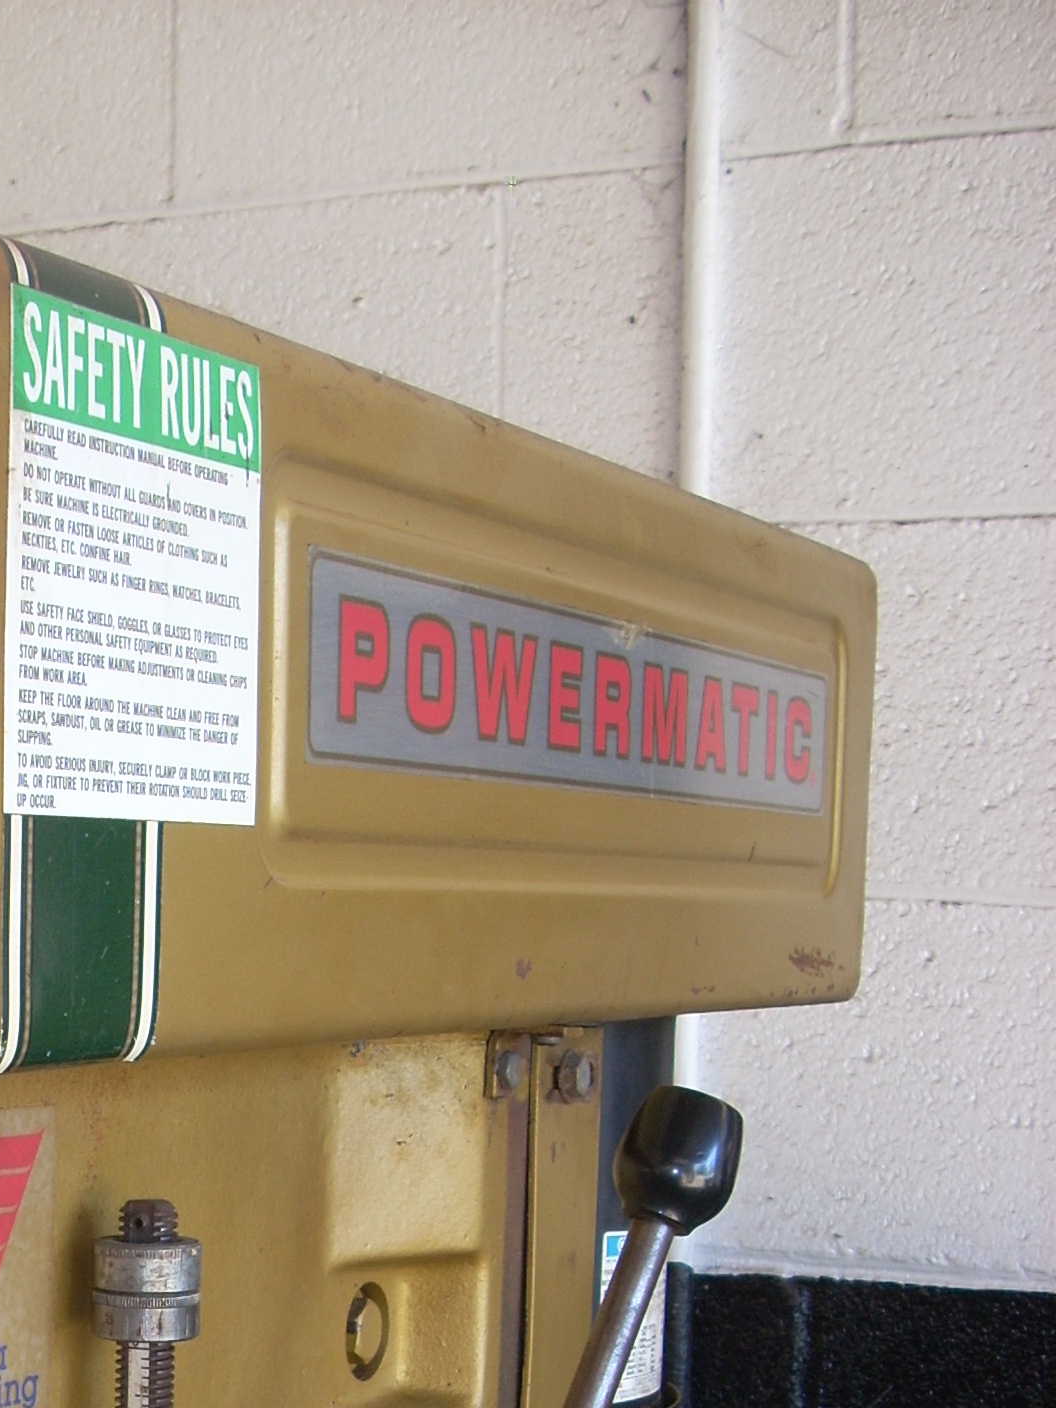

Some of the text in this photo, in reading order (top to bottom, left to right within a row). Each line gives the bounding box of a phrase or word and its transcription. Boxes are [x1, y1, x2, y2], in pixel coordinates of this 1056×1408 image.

[23, 301, 253, 460] SAFETY RULES
[23, 417, 228, 485] CAREFULLY READ INSTRUCTION MANUAL BEFORE OPERATING
[22, 461, 34, 479] DO
[35, 464, 51, 483] NOT
[53, 469, 86, 491] OPERATE
[88, 477, 121, 499] WITHOUT
[123, 486, 135, 503] ALL
[138, 489, 165, 510] GUARDS
[182, 500, 207, 520] COVERS
[22, 485, 31, 502] BE
[34, 488, 53, 507] SURE
[56, 493, 89, 515] MACHINE
[91, 501, 99, 517] IS
[101, 503, 149, 529] ELECTRICALLY
[22, 509, 227, 567] REMOVE OR FASTEN LOOSE ARTICLES OF SUCH AS
[20, 554, 119, 587] REMOVE JEWELRY SUCH AS
[19, 598, 33, 615] USE
[36, 601, 63, 620] SAFETY
[66, 606, 84, 623] FACE
[151, 621, 161, 636] OR
[193, 628, 202, 643] TO
[203, 629, 231, 647] PROTECT
[233, 634, 248, 650] EYES
[19, 619, 35, 636] AND
[37, 622, 62, 640] OTHER
[65, 626, 102, 646] PERSONAL
[105, 633, 131, 650] SAFETY
[133, 637, 172, 659] EQUIPMENT
[174, 644, 183, 658] AS
[18, 643, 195, 682] STOP MACHINE BEFORE MAKING ADJUSTMENTS OR
[18, 663, 39, 680] FROM
[42, 667, 64, 683] WORK
[18, 688, 239, 727] KEEP THE FLOOR AROUND THE MACHINE CLEAN AND FREE FROM
[337, 594, 812, 784] POWERMATIC
[103, 717, 114, 733] OR
[116, 719, 142, 735] GREASE
[145, 722, 154, 737] TO
[188, 727, 200, 741] THE
[203, 728, 228, 744] DANGER
[230, 731, 238, 745] OF
[17, 752, 230, 783] TO AVOID SERIOUS SECURELY CLAMP OR BLOCK WORK
[32, 774, 208, 800] OR FIXTURE TO PREVENT THEIR SHOULD
[16, 793, 26, 807] UP
